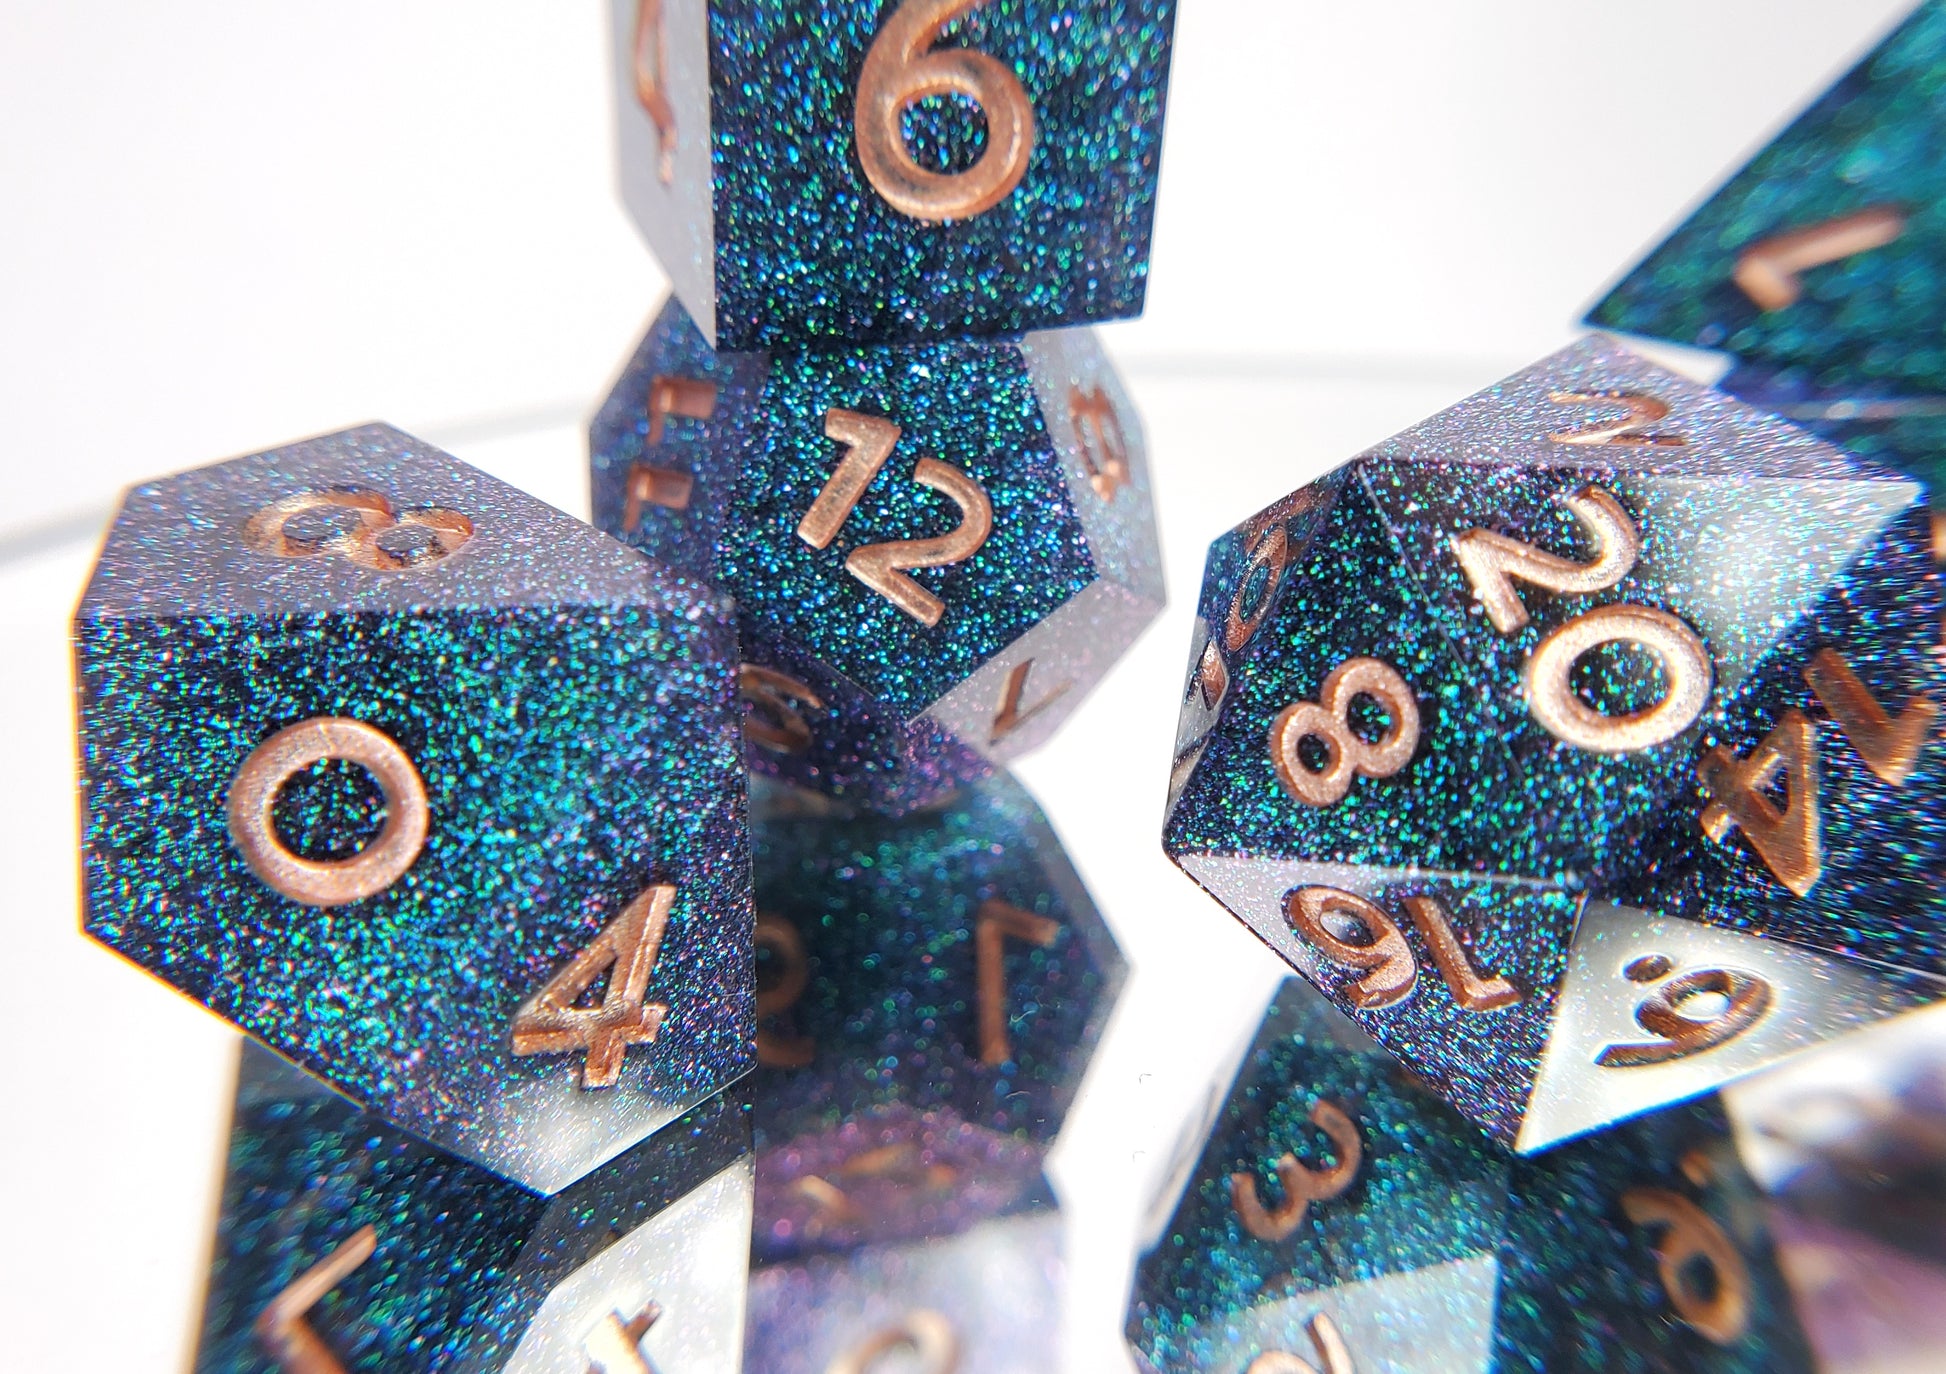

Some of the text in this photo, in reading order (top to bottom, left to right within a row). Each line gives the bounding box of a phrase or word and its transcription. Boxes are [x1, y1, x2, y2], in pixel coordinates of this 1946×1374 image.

[854, 0, 1034, 220] 6
[798, 408, 992, 627] 12
[1452, 485, 1713, 751] 20
[228, 716, 431, 907] 0
[1269, 657, 1420, 807] 8
[511, 884, 678, 1089] 4
